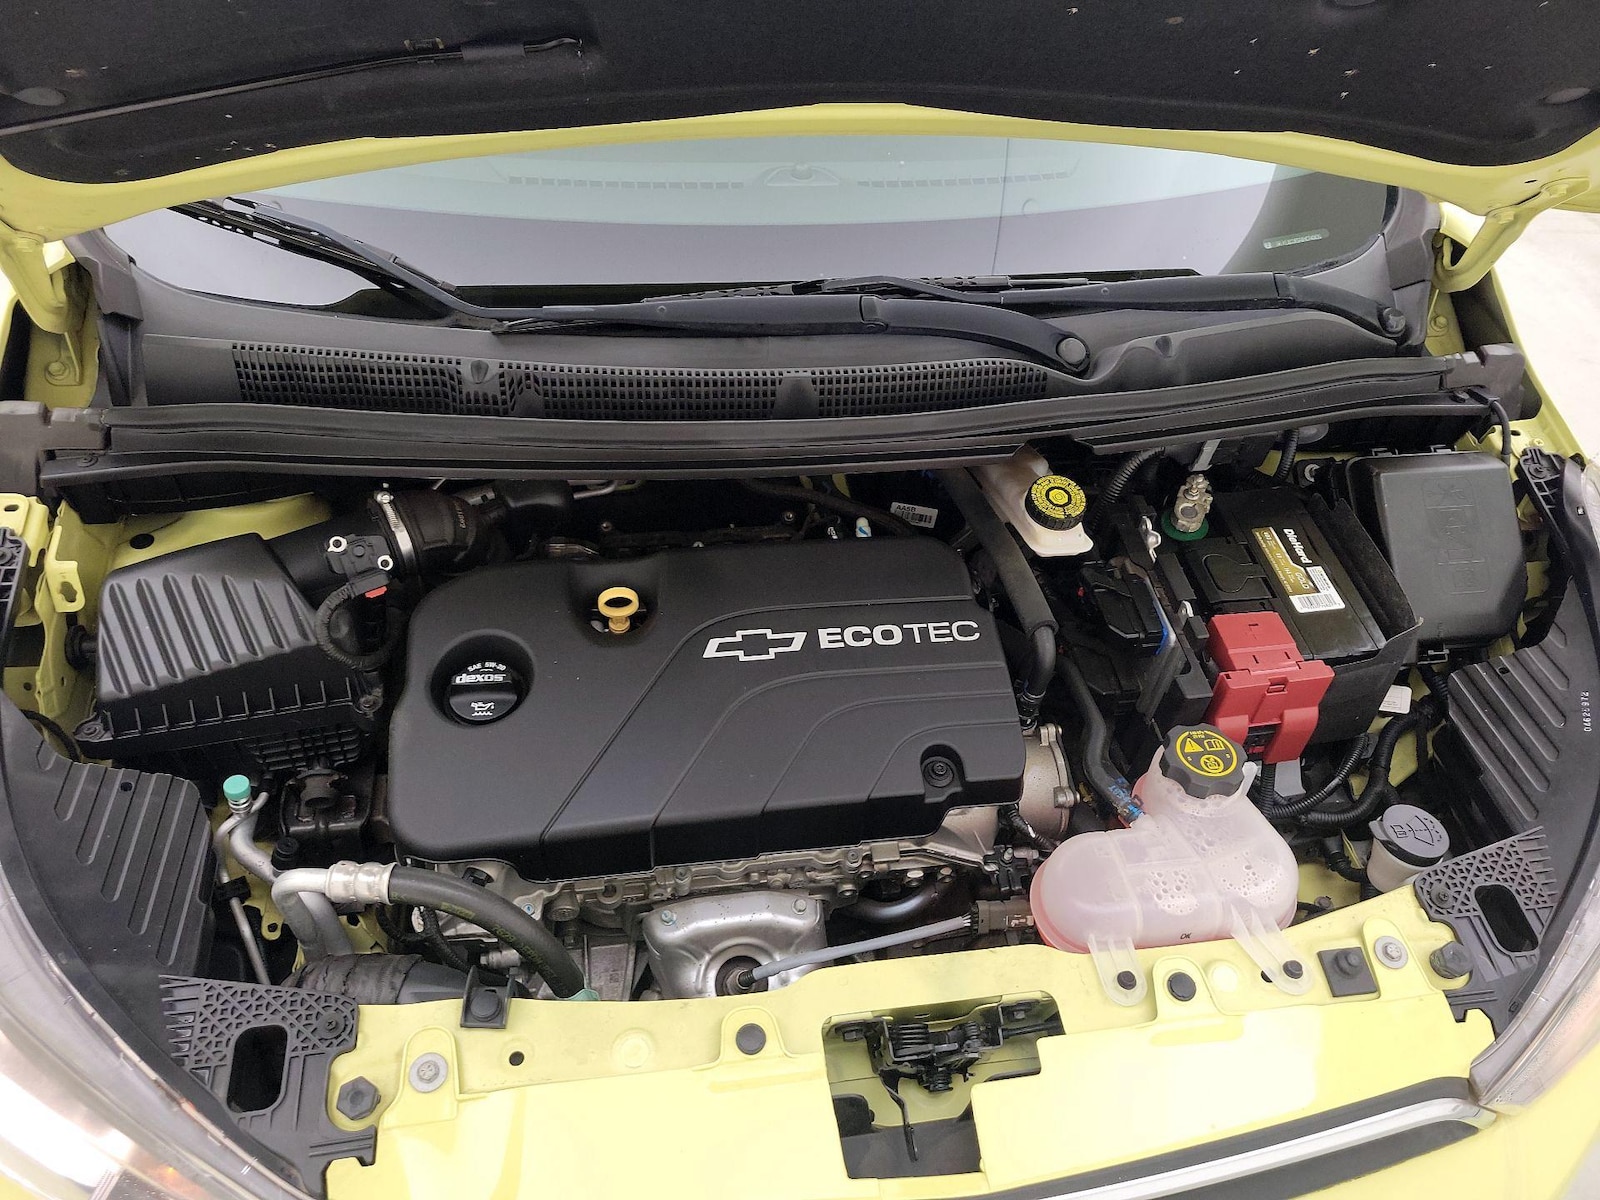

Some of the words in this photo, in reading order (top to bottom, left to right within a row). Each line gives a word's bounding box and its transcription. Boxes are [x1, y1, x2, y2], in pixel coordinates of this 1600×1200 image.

[1283, 528, 1313, 564] DieHard
[1295, 571, 1310, 590] GOLD
[817, 620, 981, 649] ECOTEC
[467, 662, 482, 672] SAE
[455, 673, 507, 684] dexos
